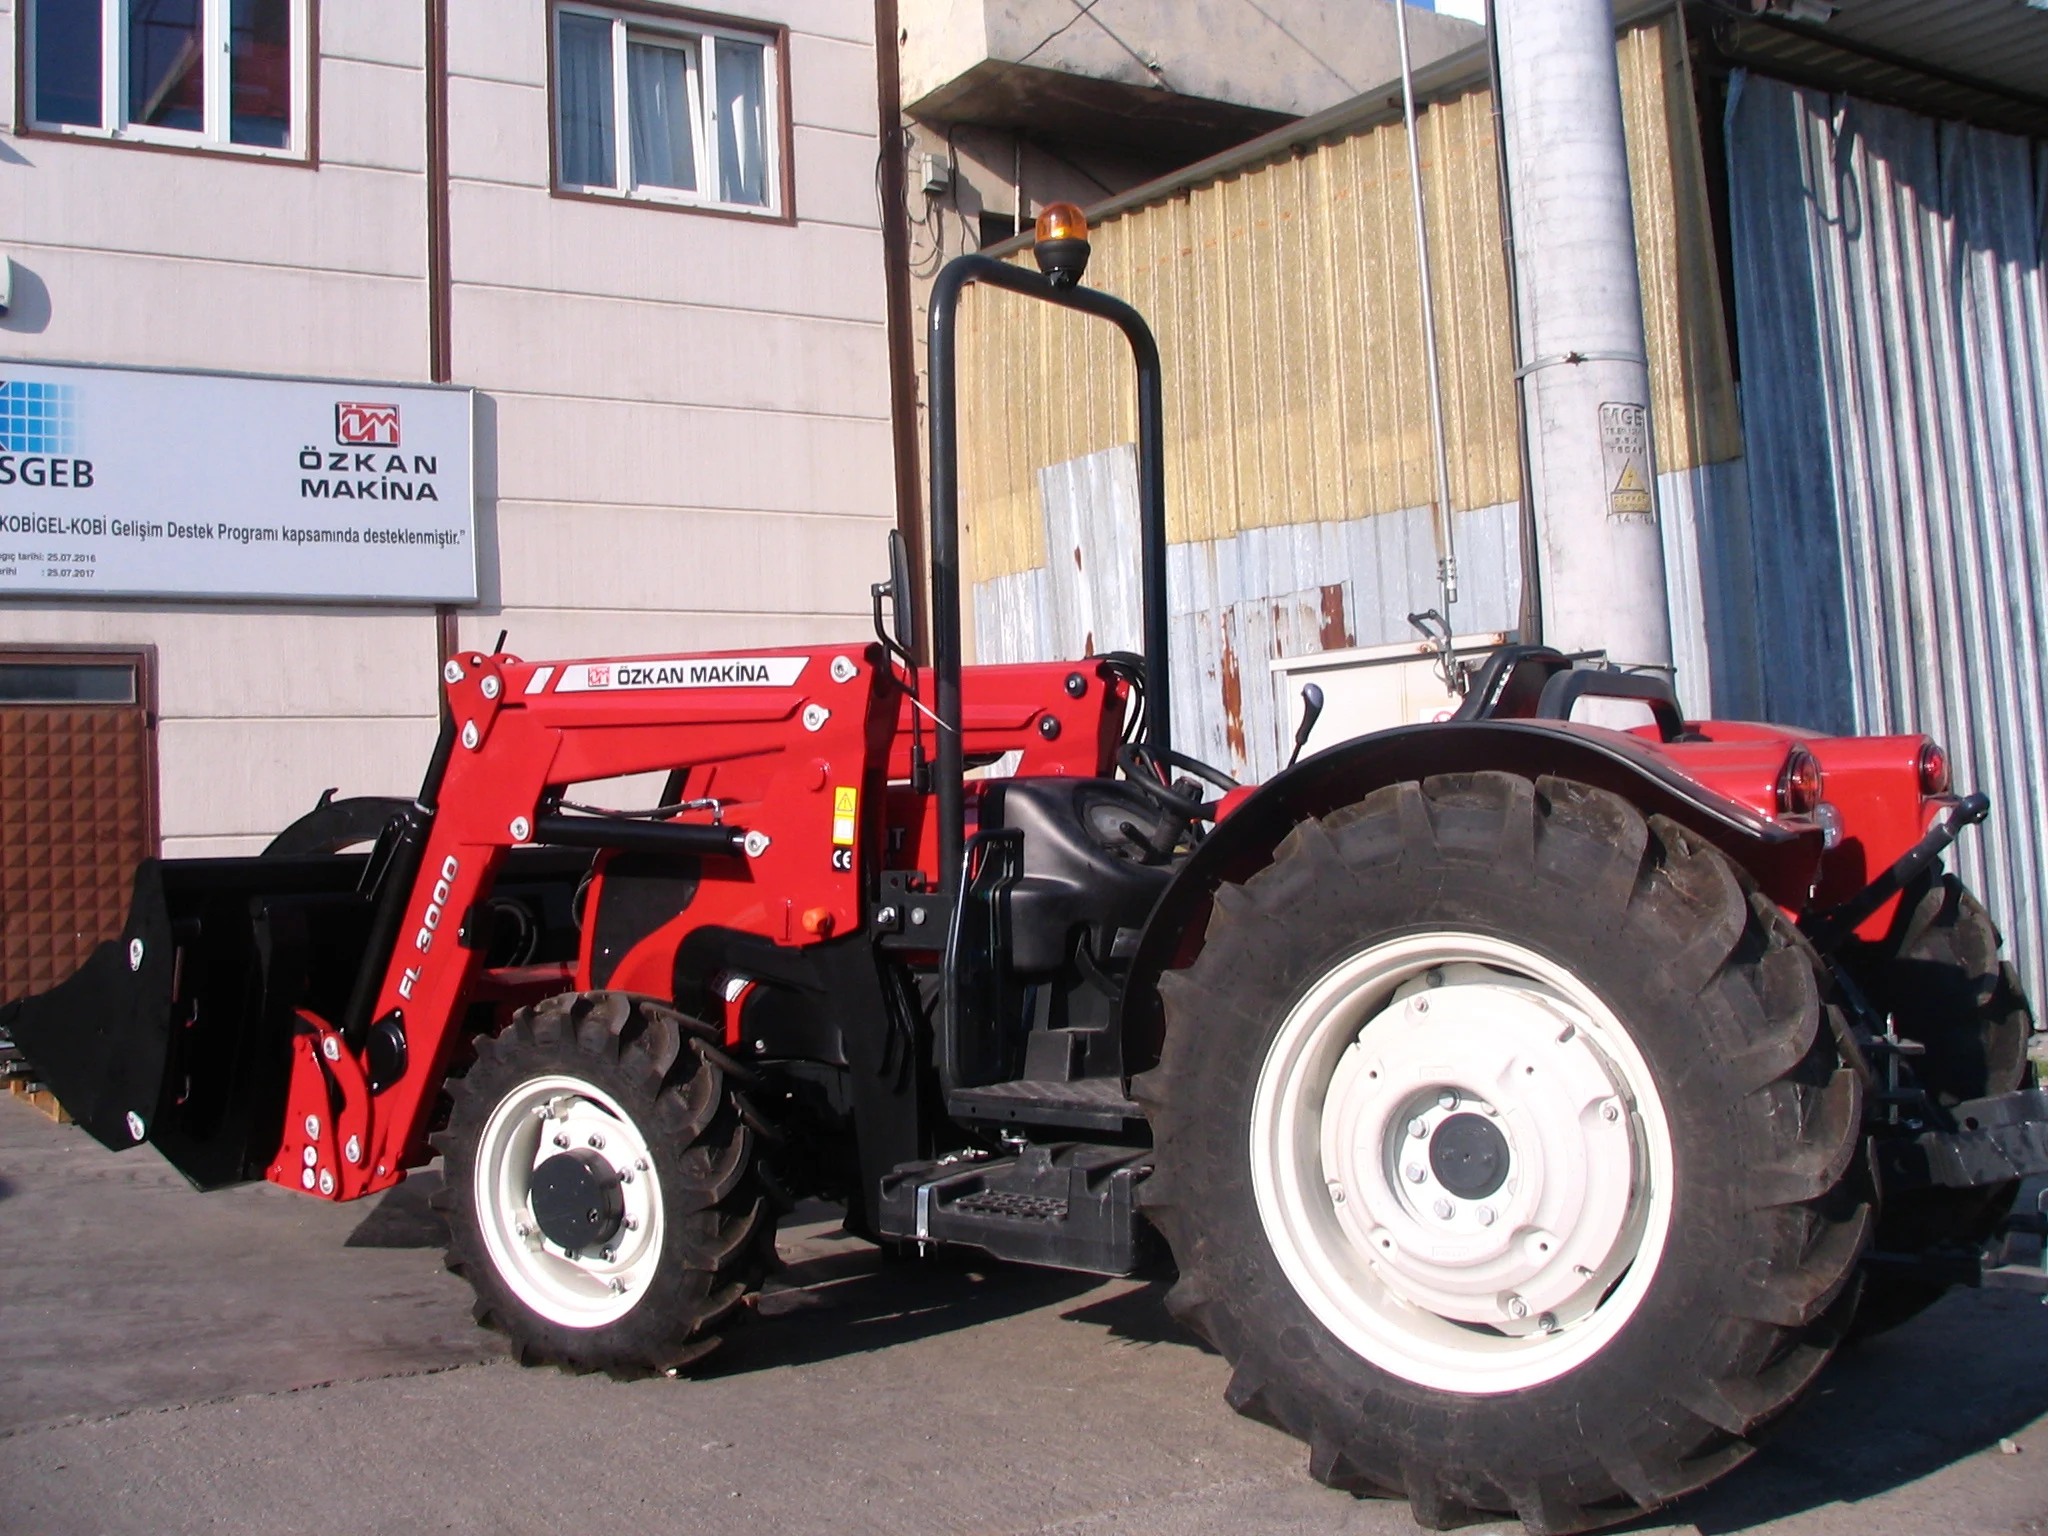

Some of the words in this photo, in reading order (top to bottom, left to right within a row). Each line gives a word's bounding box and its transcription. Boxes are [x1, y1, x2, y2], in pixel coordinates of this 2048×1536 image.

[0, 456, 95, 488] SGEB
[299, 445, 437, 474] ÖZKAN
[301, 475, 439, 501] MAKİNA
[0, 512, 107, 535] KOBİGEL-KOBİ
[111, 519, 163, 541] Gelişim
[167, 521, 214, 539] Destek
[218, 523, 279, 544] Programı
[282, 525, 360, 546] kapsamında
[47, 553, 96, 562] 25.07.2016
[47, 568, 95, 578] 25.07.2017
[618, 665, 684, 685] ÖZKAN
[690, 661, 770, 684] MAKİNA
[399, 964, 422, 1000] FL
[416, 855, 459, 954] 3000
